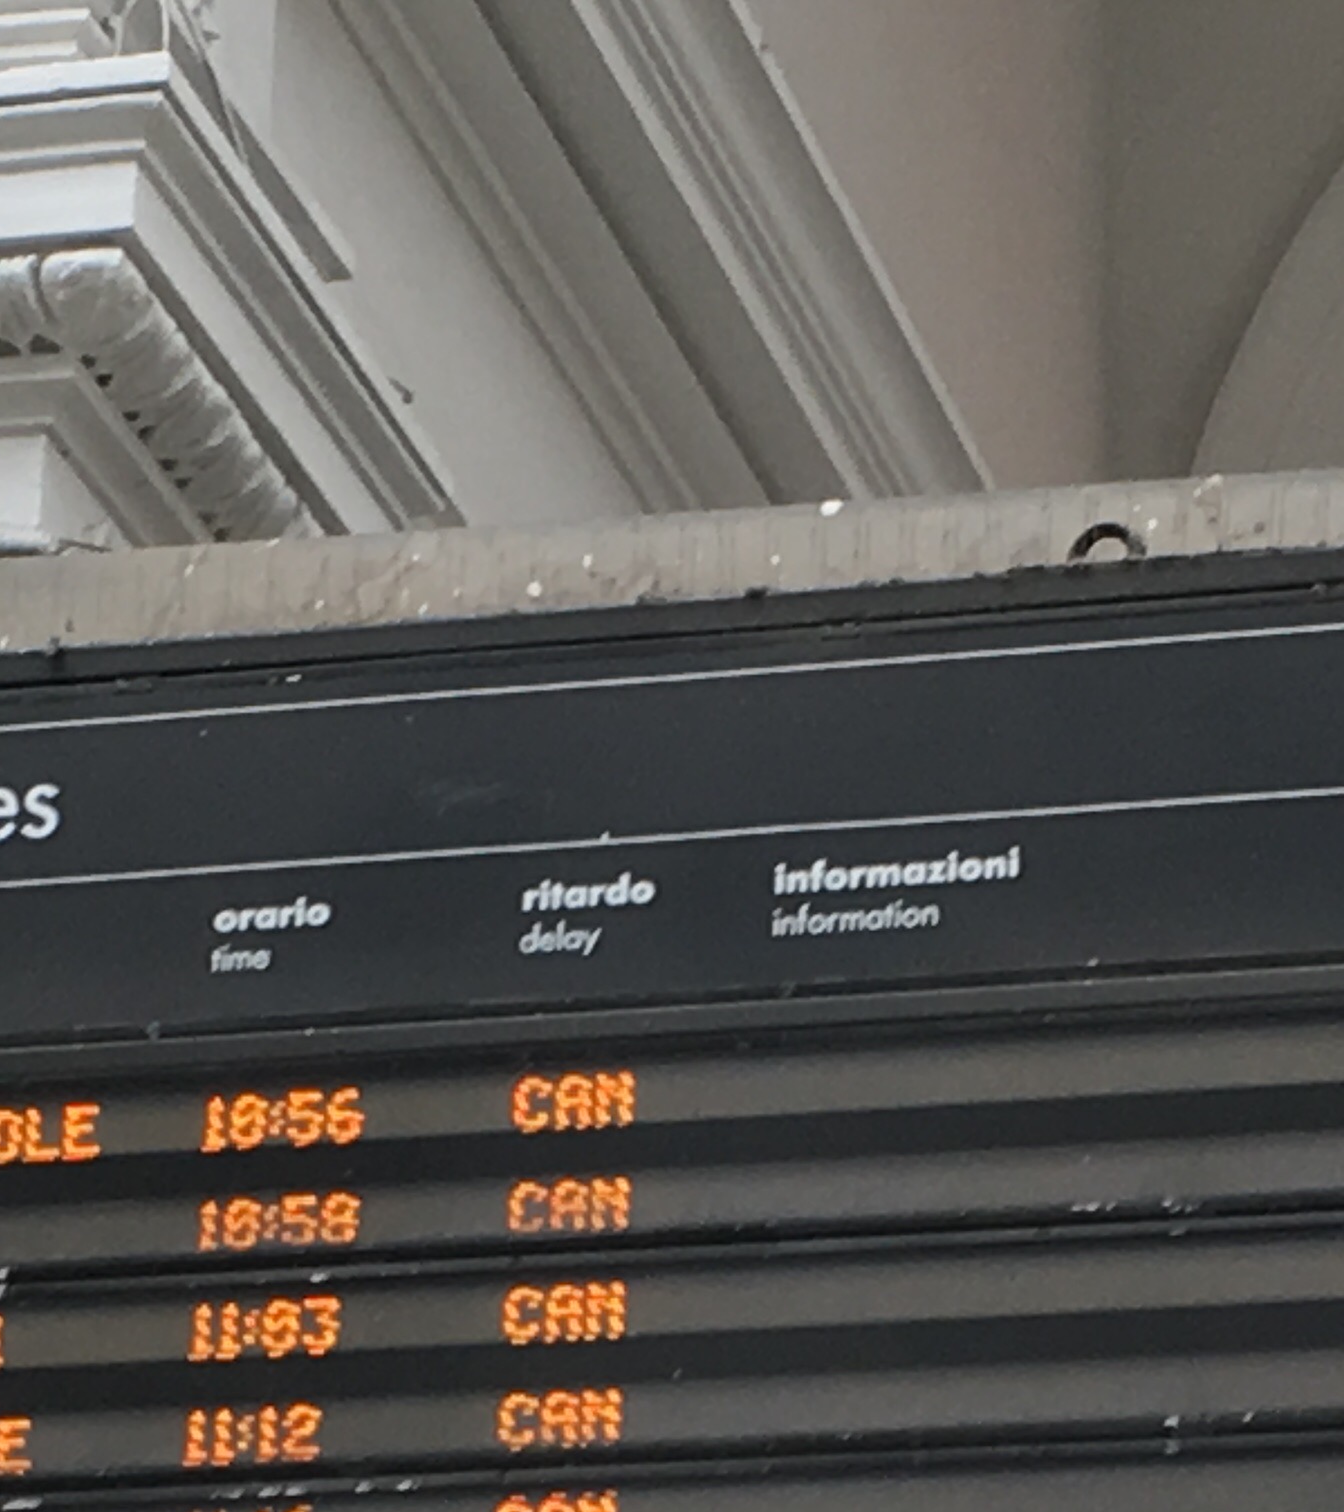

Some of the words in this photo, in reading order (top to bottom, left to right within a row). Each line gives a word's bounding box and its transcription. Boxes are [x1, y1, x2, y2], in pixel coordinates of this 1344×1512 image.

[522, 872, 656, 912] ritardo
[774, 846, 1020, 895] informazioni
[213, 896, 331, 933] orario
[519, 920, 602, 956] delay
[771, 899, 940, 936] information
[211, 944, 271, 972] time
[200, 1086, 367, 1153] 10:56
[510, 1070, 637, 1134] CAN
[197, 1191, 362, 1252] 10:58
[506, 1176, 633, 1233] CAN
[187, 1295, 342, 1362] 11:03
[500, 1280, 628, 1346] CAN
[181, 1402, 323, 1468] 11:12
[496, 1387, 624, 1452] CAN
